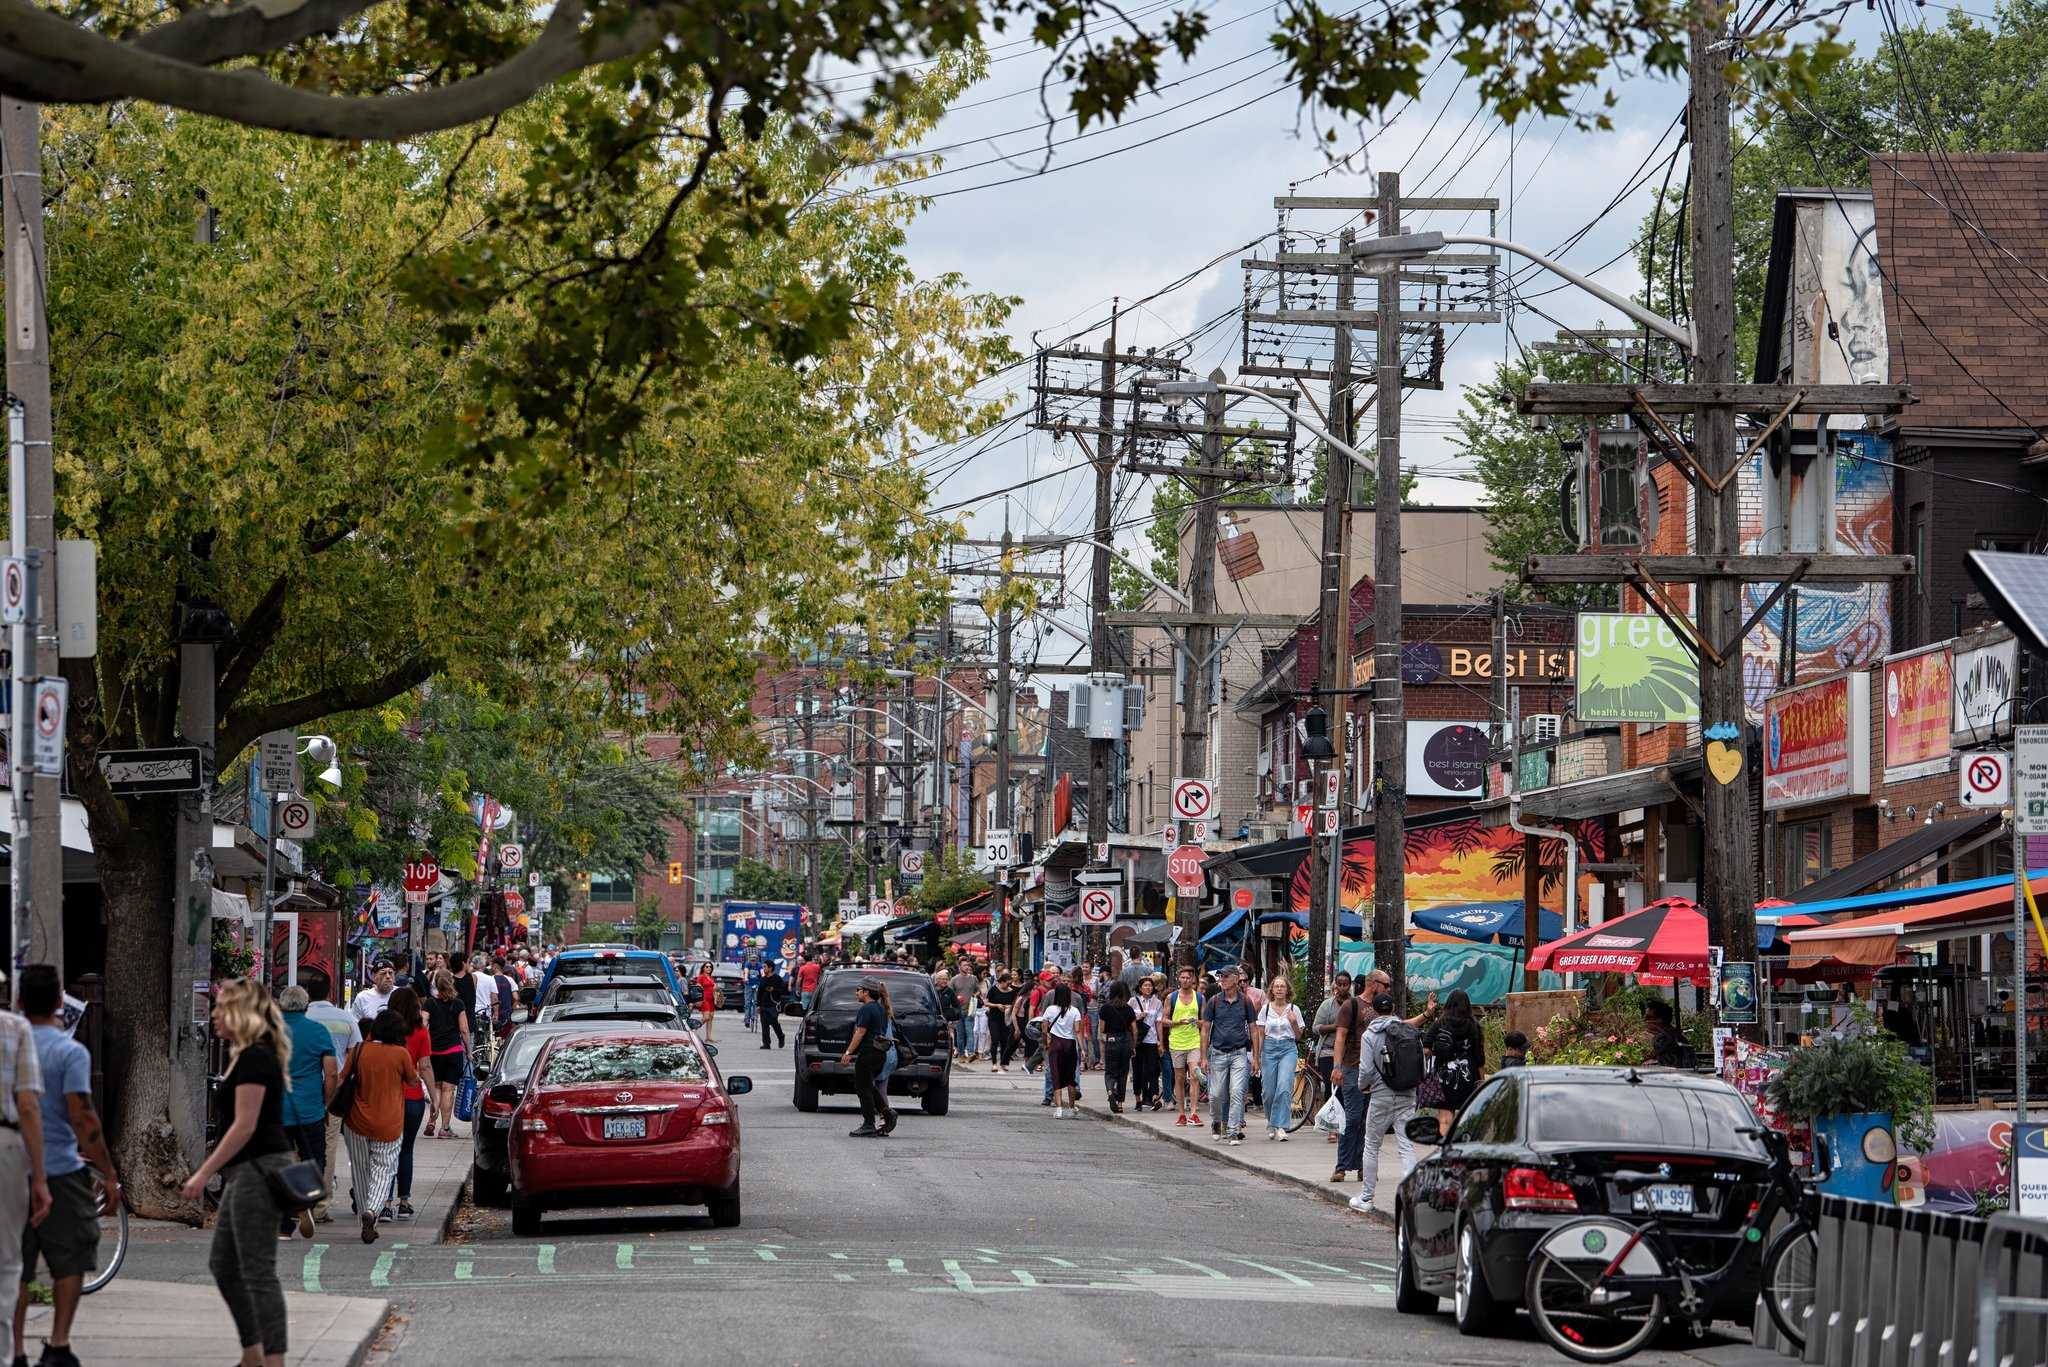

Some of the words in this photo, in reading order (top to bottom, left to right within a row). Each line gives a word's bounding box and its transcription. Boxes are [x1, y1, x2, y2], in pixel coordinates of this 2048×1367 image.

[1451, 648, 1528, 677] Best
[1590, 708, 1618, 716] health
[1628, 709, 1659, 719] beauty
[2018, 728, 2031, 736] PAY
[1429, 758, 1451, 769] best
[988, 844, 1008, 861] 30
[840, 910, 857, 920] 30
[1559, 956, 1579, 966] GREAT
[1581, 955, 1597, 964] BEER
[1598, 955, 1616, 964] LIVES
[1617, 956, 1637, 966] HERE
[1655, 962, 1676, 970] Mill
[1669, 1188, 1691, 1206] 997
